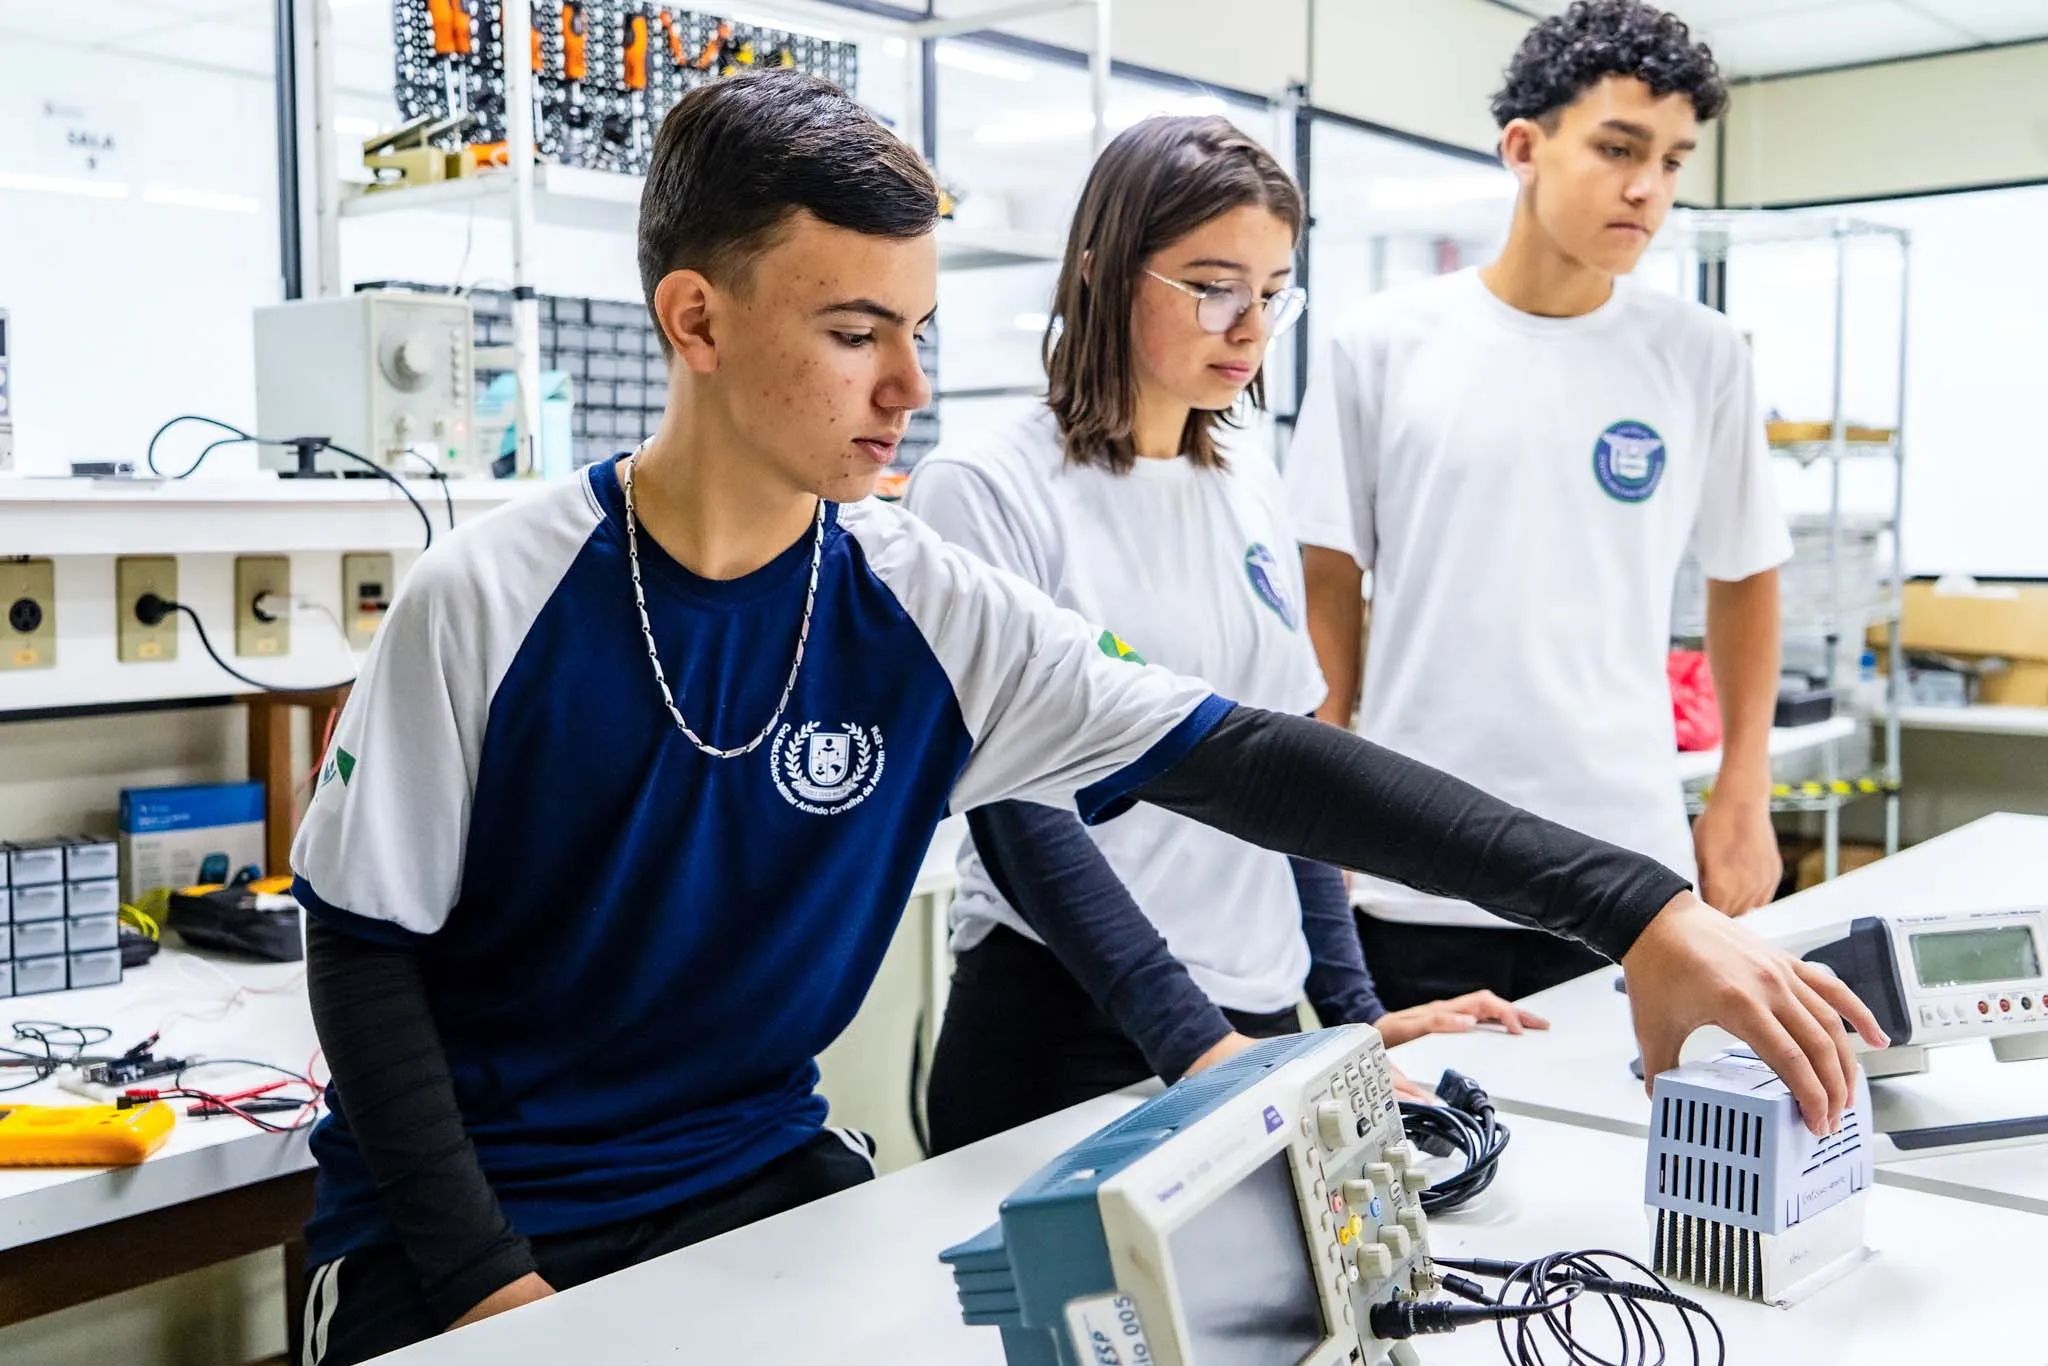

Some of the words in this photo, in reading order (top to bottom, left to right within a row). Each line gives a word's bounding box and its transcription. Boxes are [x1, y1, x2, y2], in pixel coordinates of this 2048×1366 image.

[796, 799, 829, 815] Arlindo
[829, 795, 864, 815] Carvalho
[862, 784, 874, 798] de
[868, 750, 886, 786] Amorim
[1113, 1295, 1140, 1336] 005
